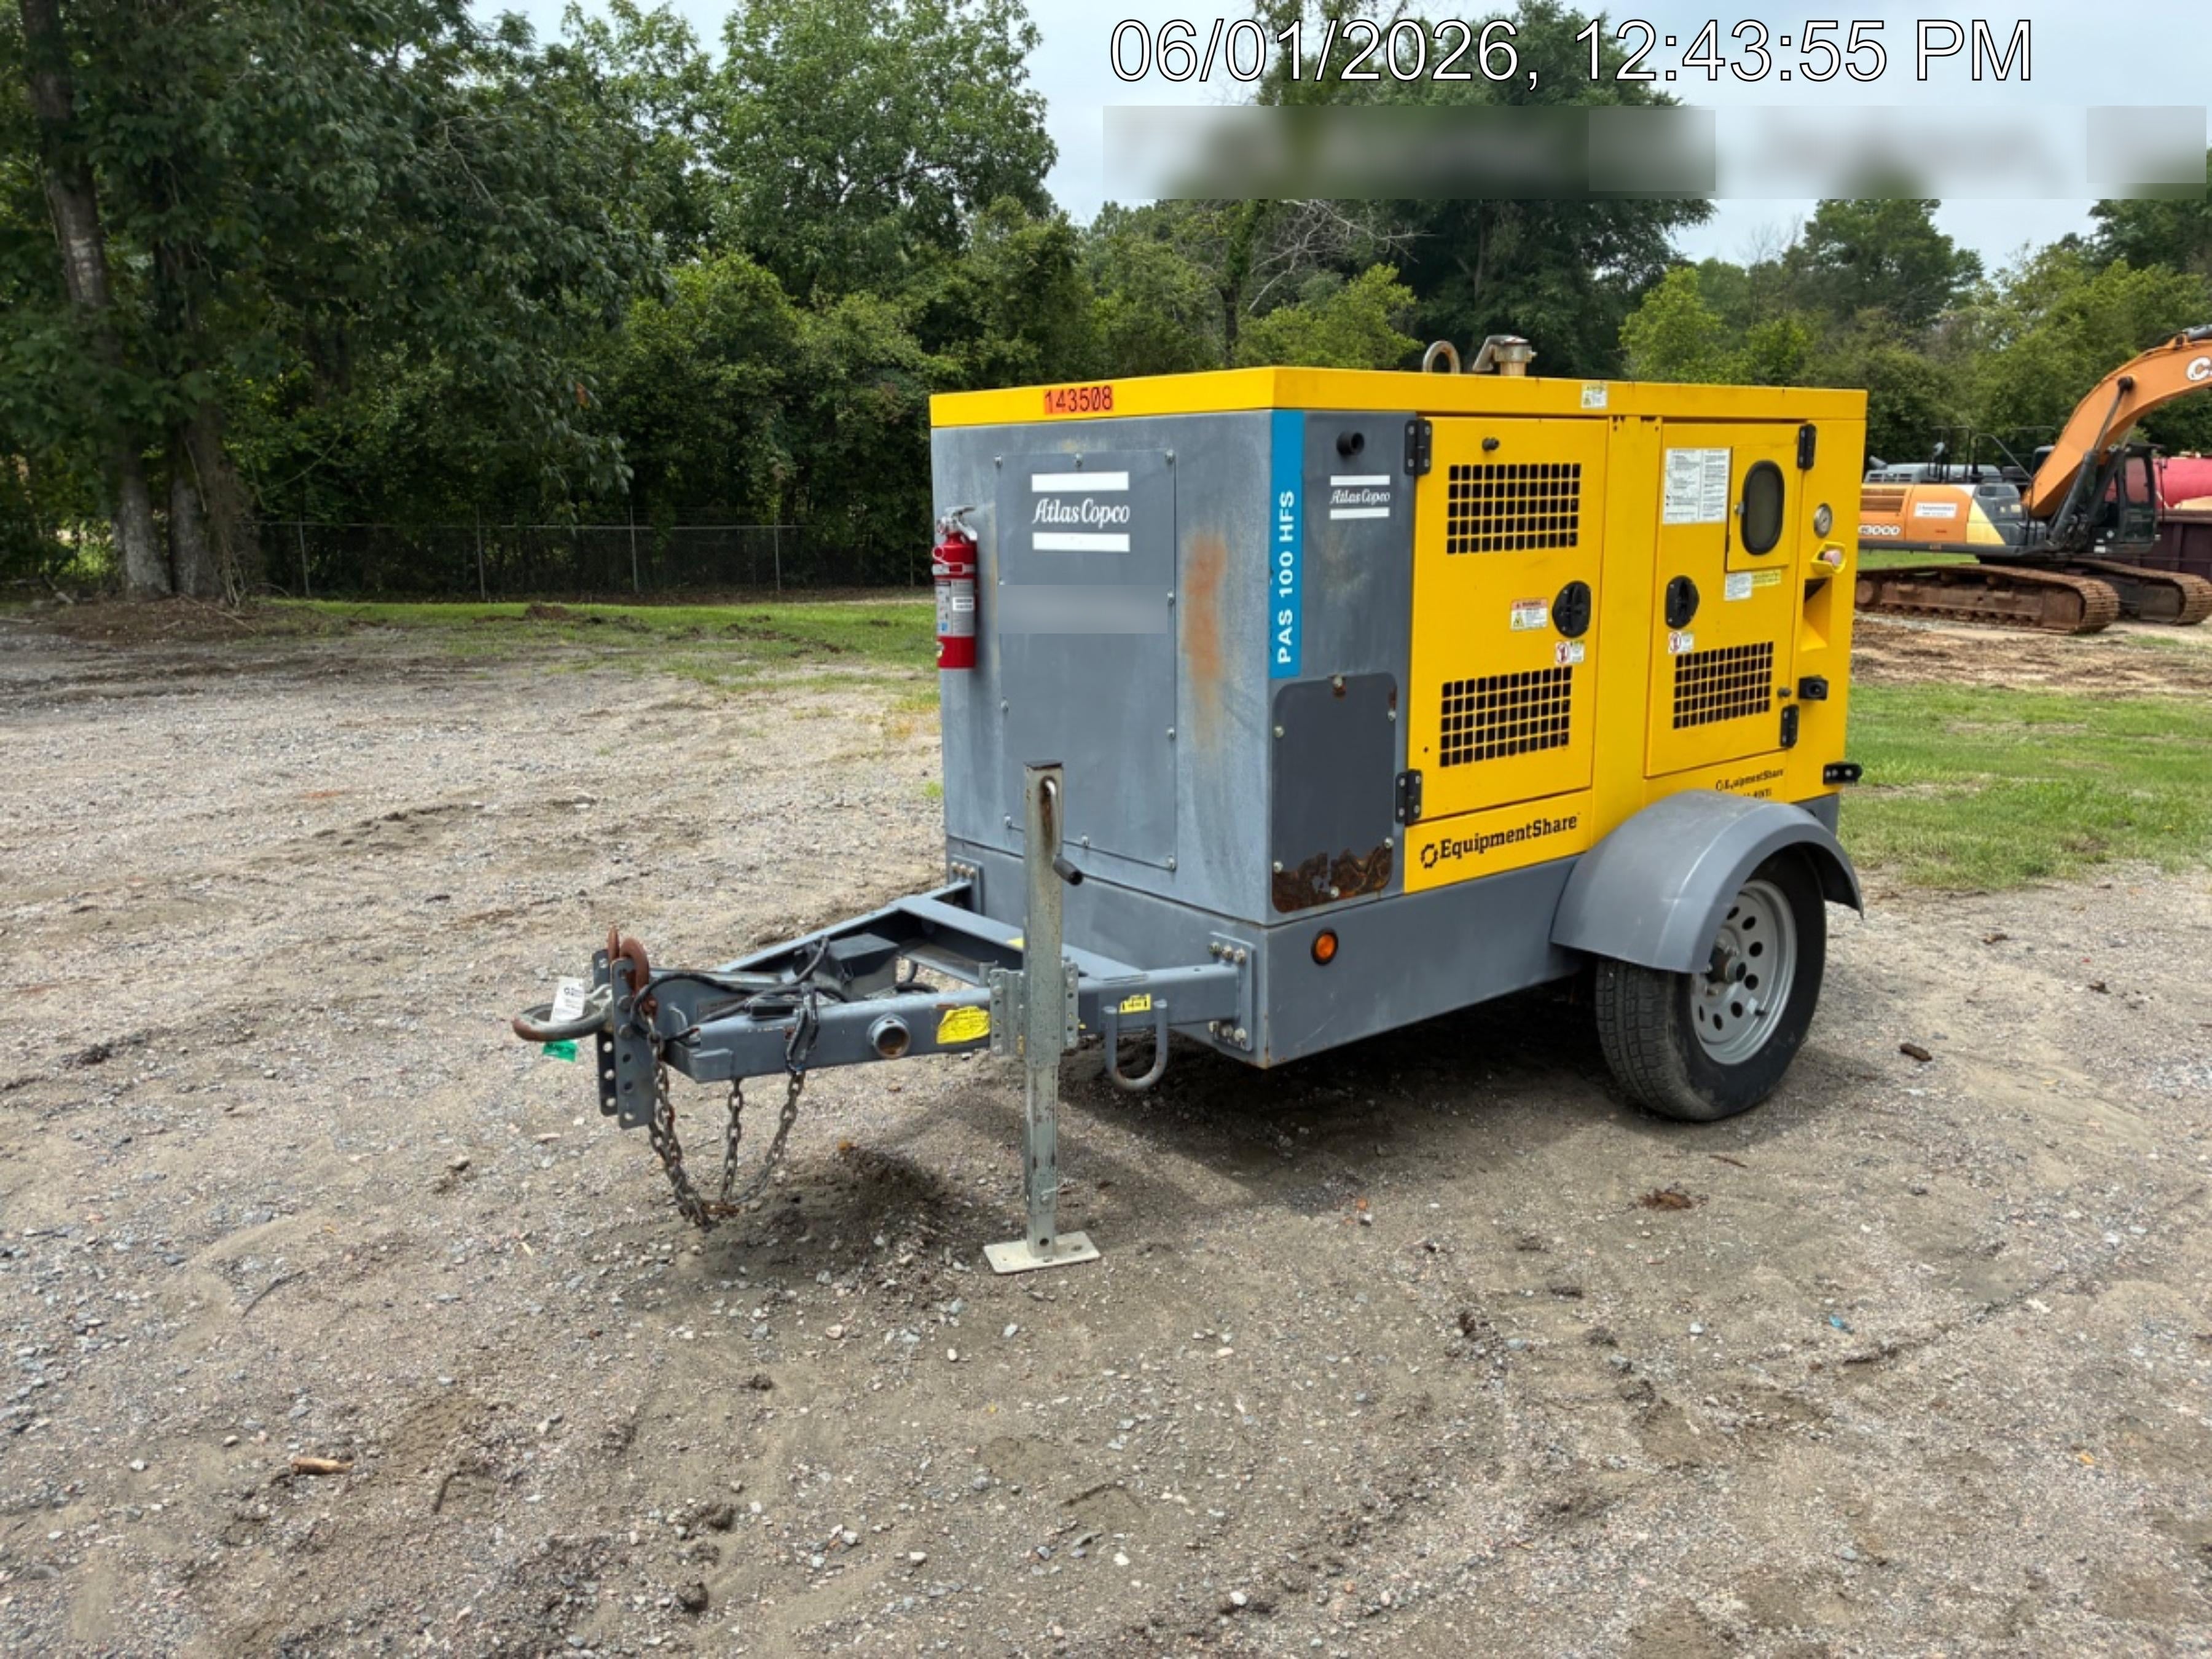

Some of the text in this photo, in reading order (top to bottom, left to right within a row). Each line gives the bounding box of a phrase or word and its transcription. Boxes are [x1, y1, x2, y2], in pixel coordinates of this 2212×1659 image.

[1045, 385, 1112, 414] 143508
[1330, 488, 1391, 506] Atlas Copco
[1032, 498, 1131, 529] Atlas Copco
[1277, 490, 1295, 664] PAS 100 HFS
[1440, 815, 1577, 860] EquipmentShare
